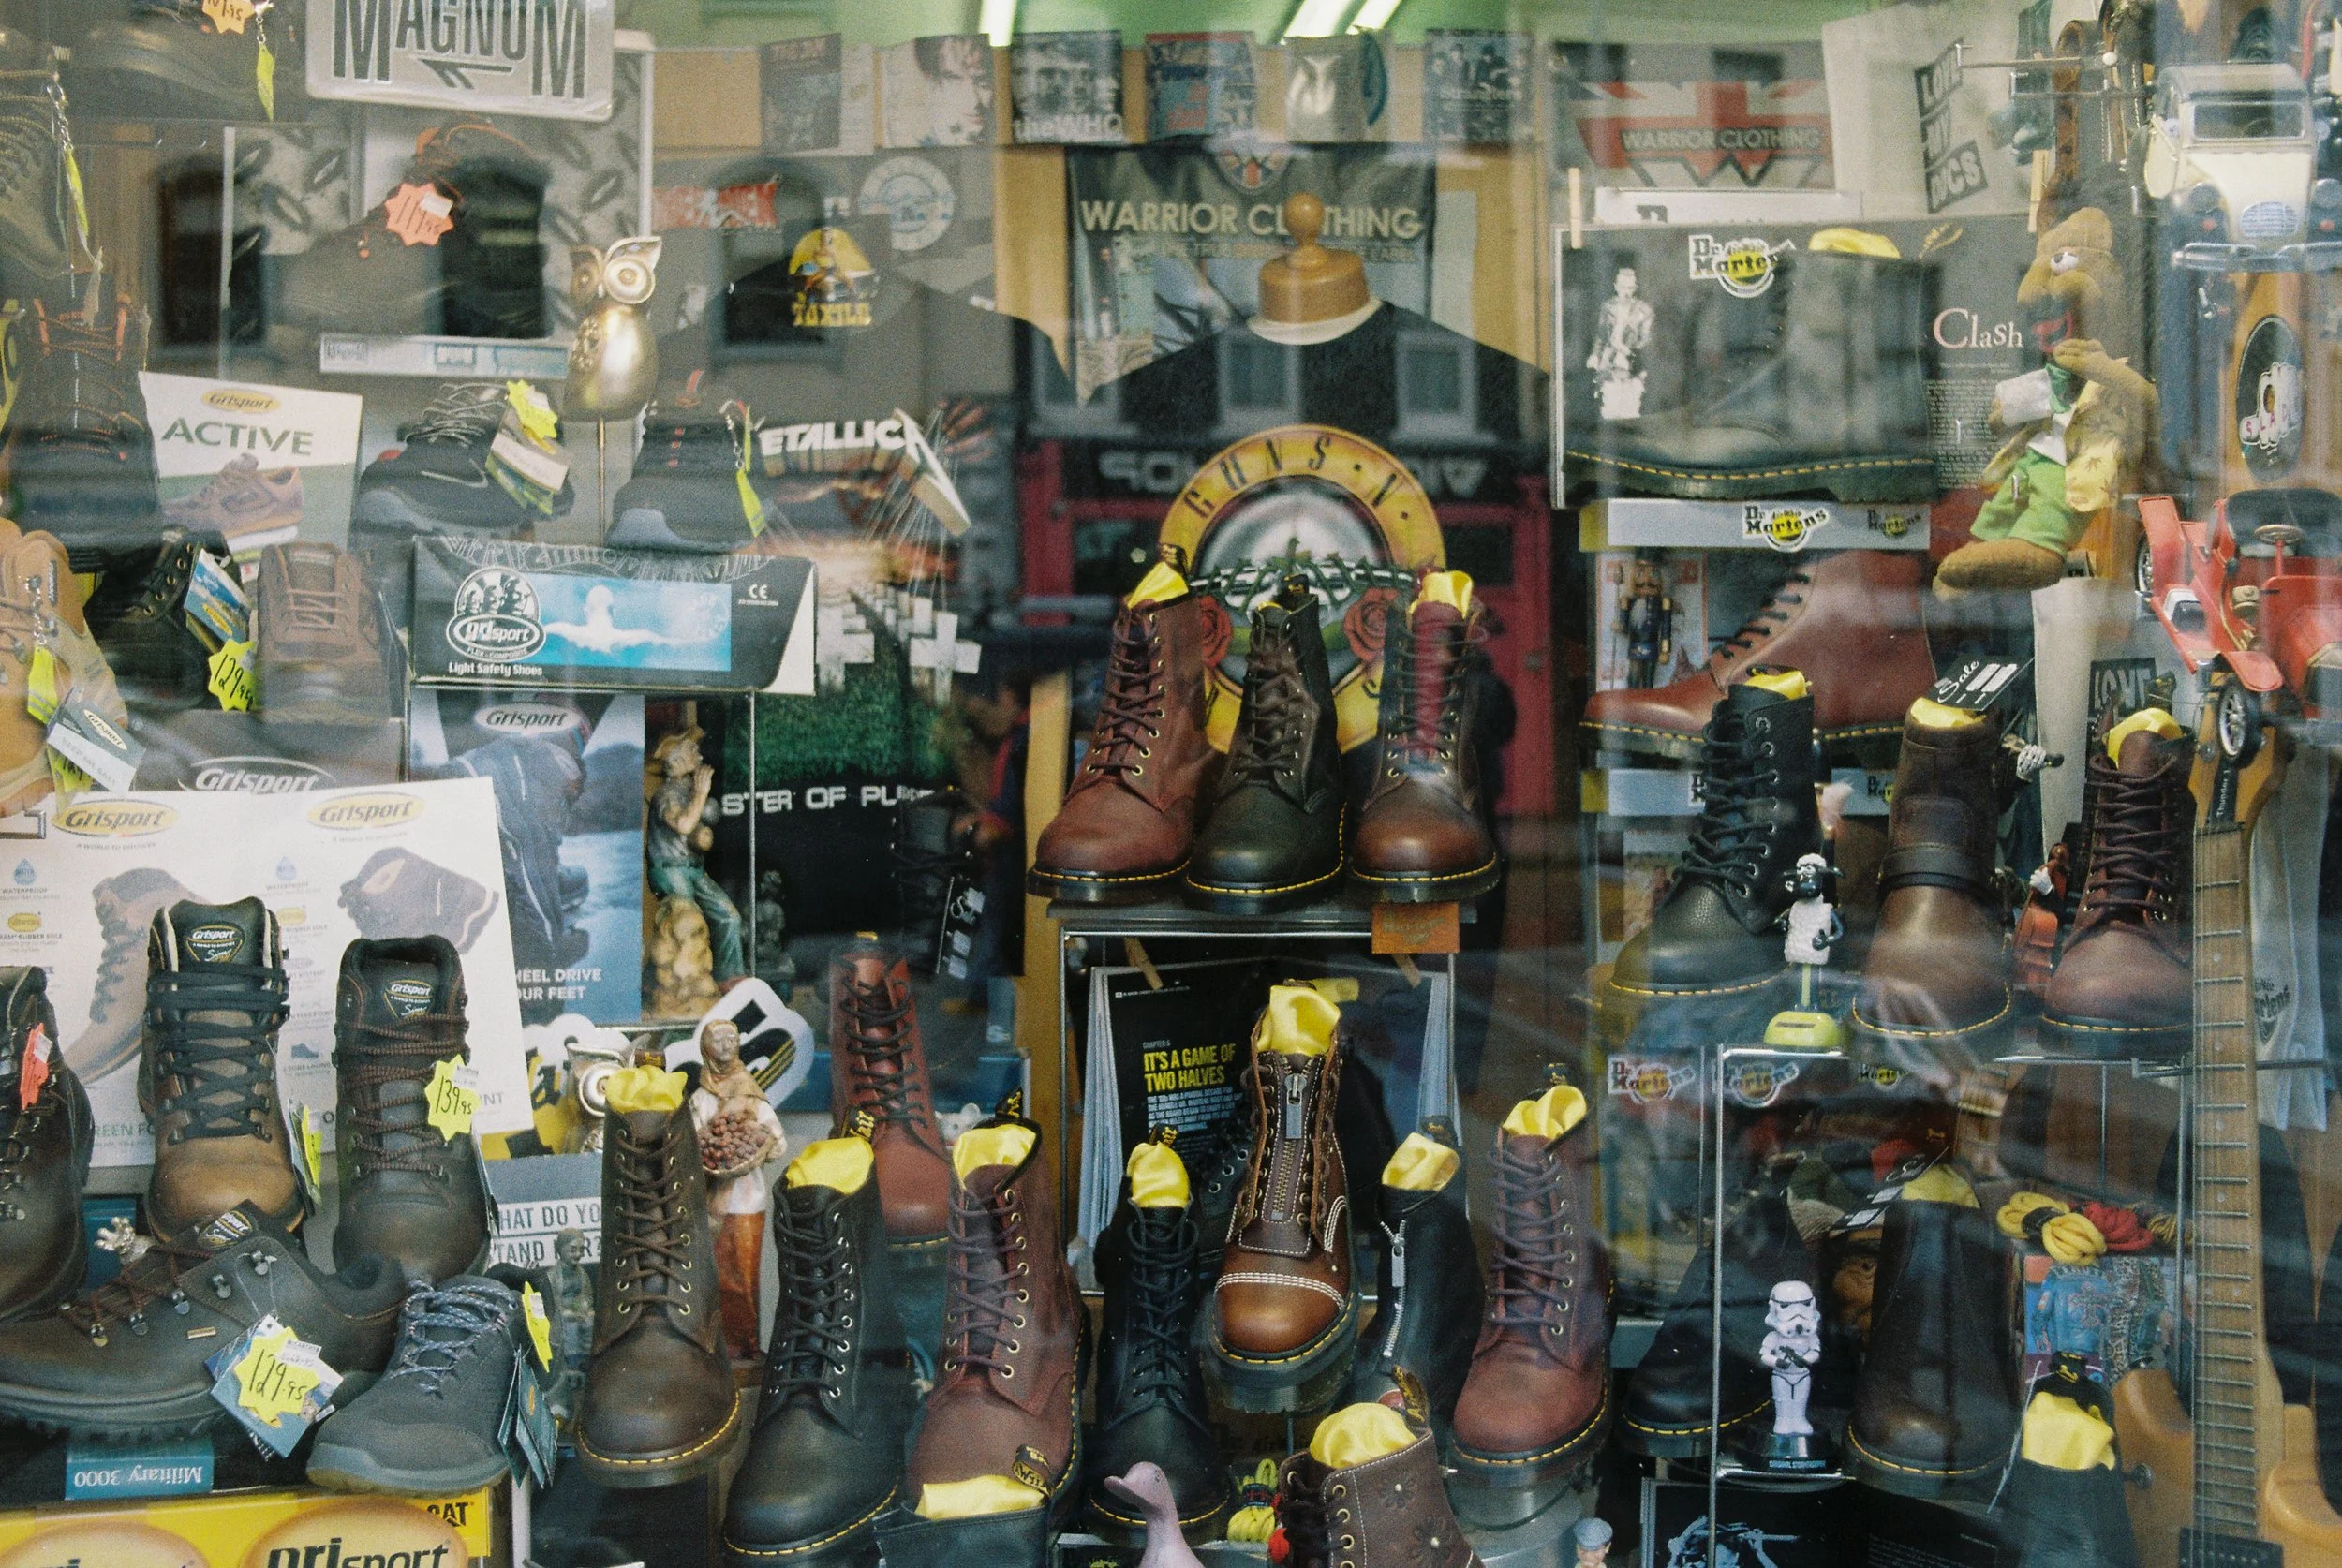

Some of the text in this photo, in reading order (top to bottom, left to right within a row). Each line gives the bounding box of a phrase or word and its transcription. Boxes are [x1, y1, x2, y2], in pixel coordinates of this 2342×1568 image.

[333, 0, 588, 99] MAGNUM
[1621, 127, 1820, 150] WARRIOR CLOTHING
[1080, 200, 1424, 240] WARRIOR CLTHING
[1694, 253, 1780, 273] Marte
[1933, 307, 2023, 349] Clash
[161, 417, 315, 456] ACTIVE
[757, 408, 971, 525] ETALLICA
[1184, 433, 1331, 519] GUNS
[1744, 510, 1828, 535] Martens
[449, 661, 543, 677] Light Safety Shoes
[1936, 659, 1980, 704] Sale
[485, 706, 569, 731] Grisport
[195, 767, 321, 795] Grisport
[319, 800, 415, 823] Grisport
[722, 789, 793, 816] STER
[805, 785, 848, 810] OF
[65, 808, 168, 830] Grisport
[191, 929, 235, 940] Grisport
[391, 984, 431, 996] Grisport
[515, 968, 602, 984] HEEL DRIVE
[548, 985, 586, 1001] FEET
[1143, 1043, 1237, 1072] IT'S A GAME OF
[1144, 1065, 1226, 1094] TWO HALVES
[435, 1074, 473, 1116] 139.95
[497, 1202, 602, 1231] HAT DO YO
[248, 1348, 309, 1402] 129.95
[74, 1465, 203, 1487] Military 3000
